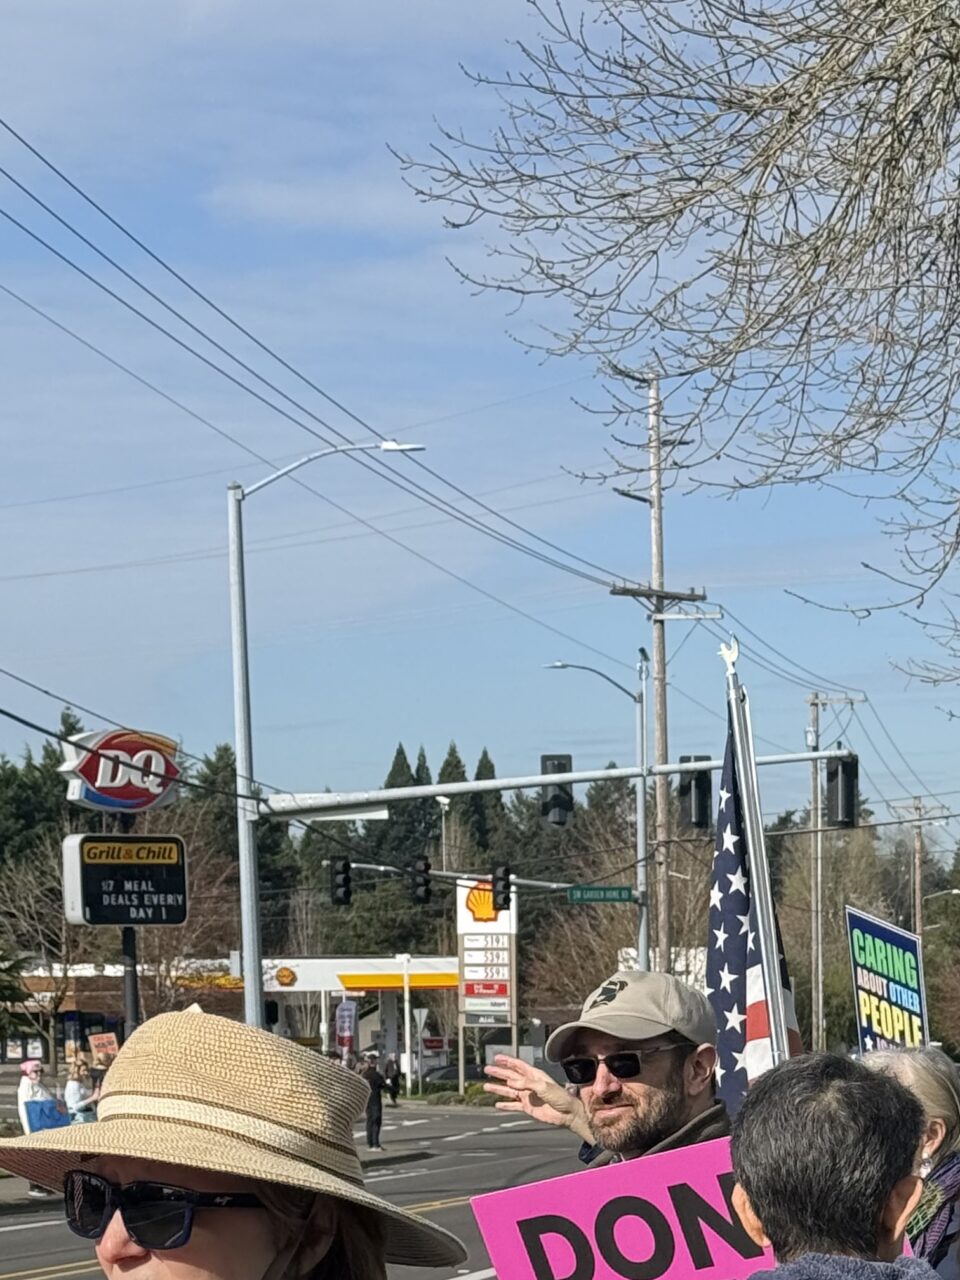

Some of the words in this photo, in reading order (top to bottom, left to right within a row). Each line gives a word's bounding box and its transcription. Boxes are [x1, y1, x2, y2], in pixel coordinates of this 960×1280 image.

[95, 749, 166, 794] DQ
[102, 894, 138, 906] DEALS
[143, 893, 183, 906] EVERY
[124, 880, 154, 892] MEAL
[130, 907, 153, 919] DAY
[852, 927, 918, 989] CARING
[857, 966, 888, 999] ABOUT
[889, 981, 920, 1014] OTHER
[858, 989, 922, 1048] PEOPLE
